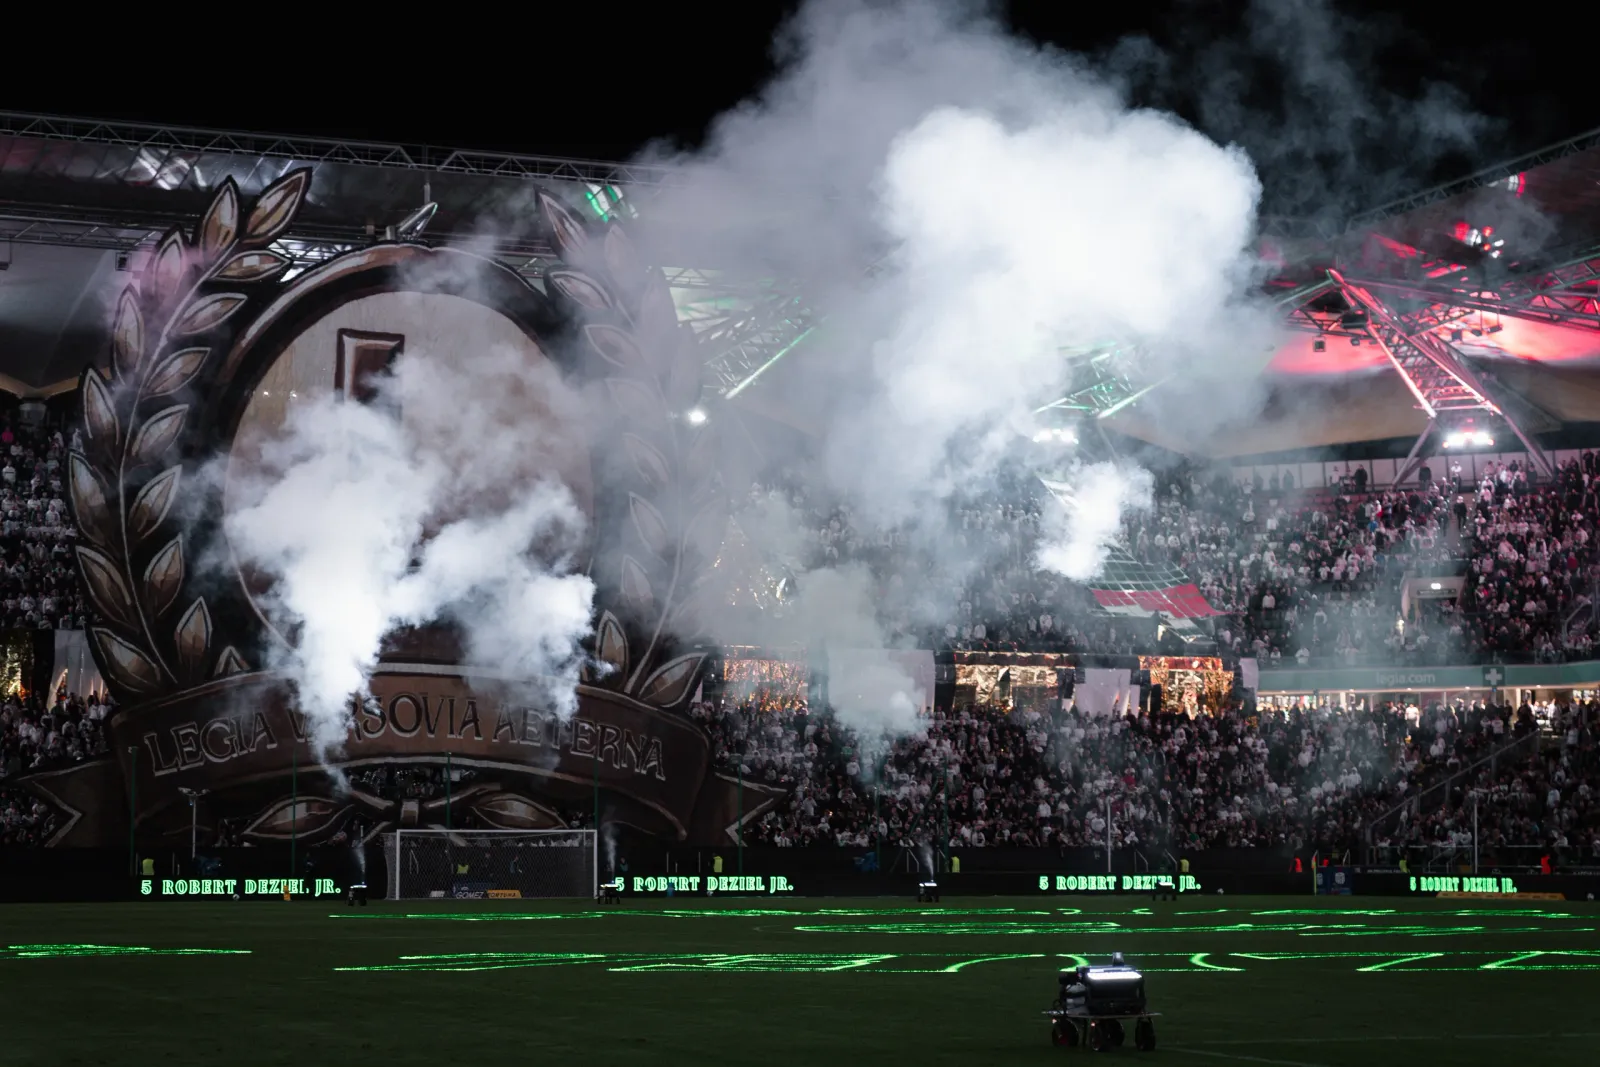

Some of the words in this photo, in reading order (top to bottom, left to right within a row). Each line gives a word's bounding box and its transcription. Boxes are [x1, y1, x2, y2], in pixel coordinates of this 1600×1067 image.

[1375, 671, 1436, 687] legia.com
[145, 709, 282, 777] LEGIA
[286, 692, 484, 744] VRSOVIA
[491, 703, 666, 781] AETERNA
[140, 880, 152, 895] 5
[162, 879, 237, 895] ROBERT
[315, 879, 342, 897] JR.
[614, 877, 625, 892] 5
[707, 876, 765, 891] DEZIEL
[770, 876, 795, 894] JR.
[1038, 876, 1050, 891] 5
[1056, 876, 1118, 891] ROBERT
[1179, 875, 1202, 893] JR.
[1409, 876, 1417, 891] 5
[1420, 876, 1460, 892] ROBERT
[1463, 877, 1500, 893] DEZIEL
[1501, 878, 1518, 894] JR.
